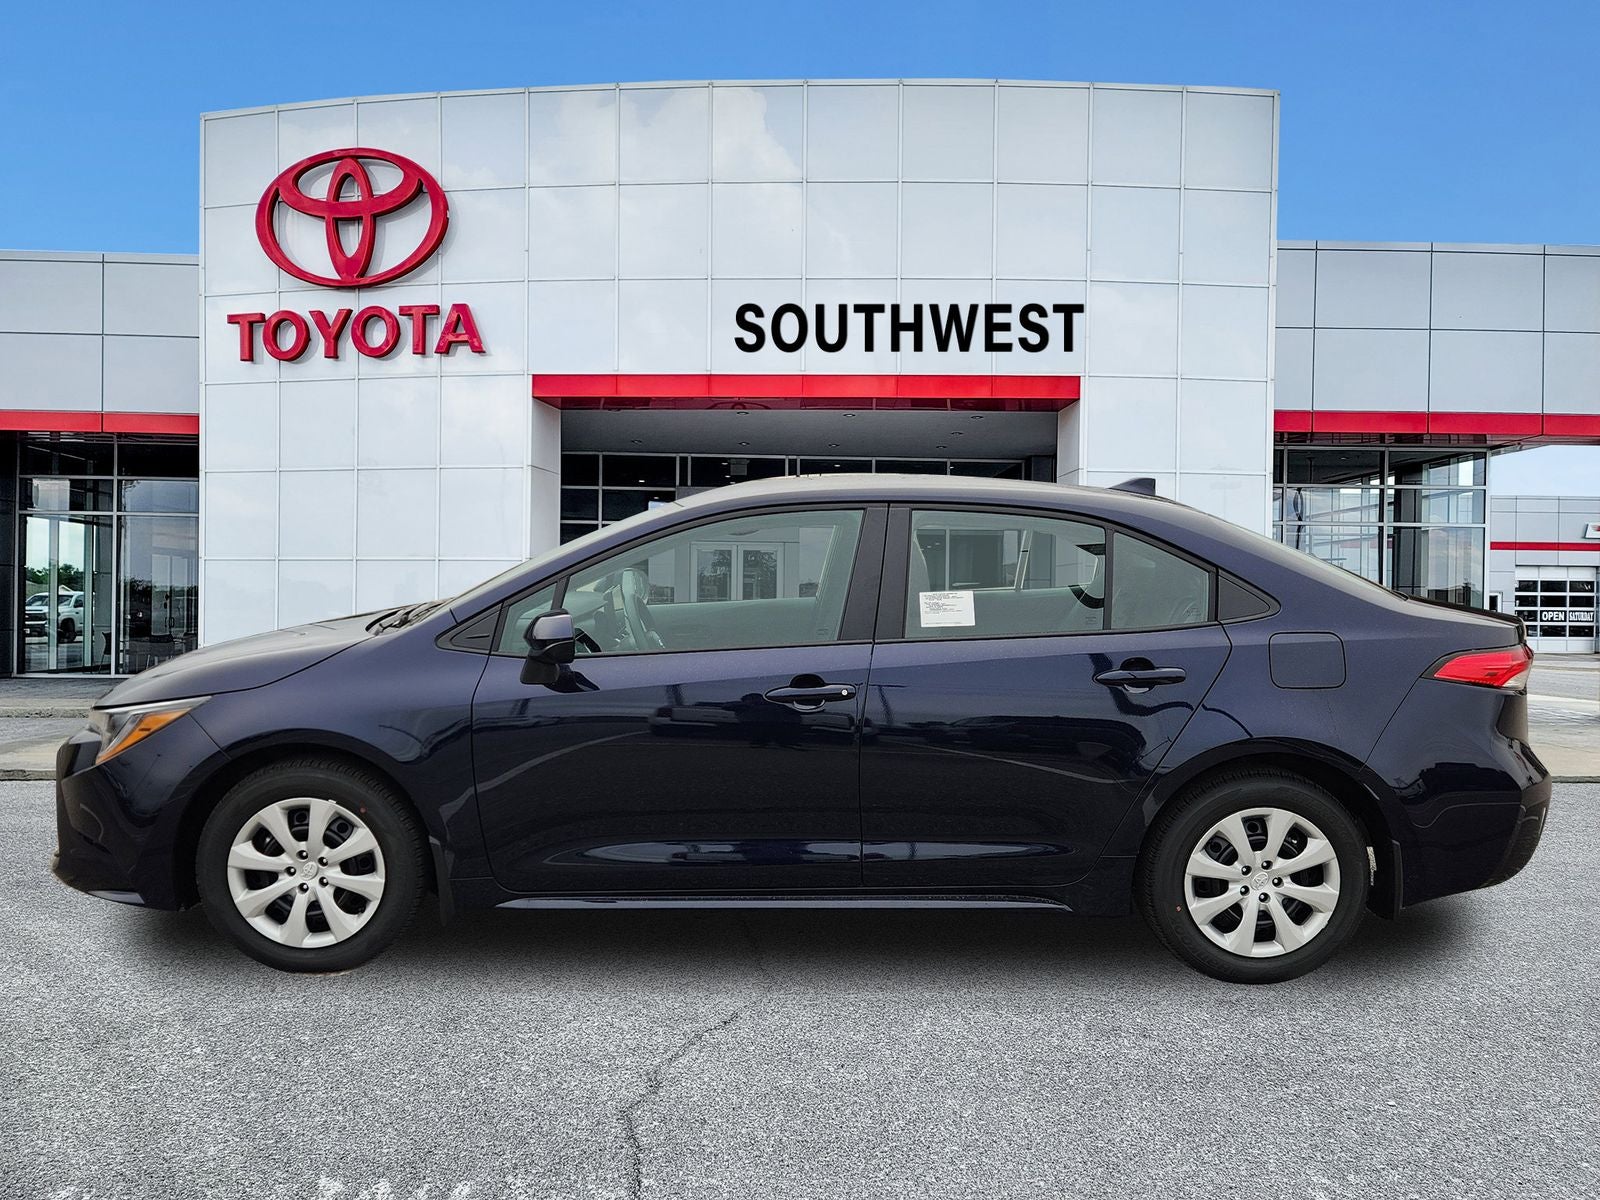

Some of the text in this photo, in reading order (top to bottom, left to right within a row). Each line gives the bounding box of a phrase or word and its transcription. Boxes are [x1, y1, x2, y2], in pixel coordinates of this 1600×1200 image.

[227, 302, 484, 361] TOYOTA
[735, 303, 1084, 352] SOUTHWEST
[1542, 611, 1565, 621] OPEN
